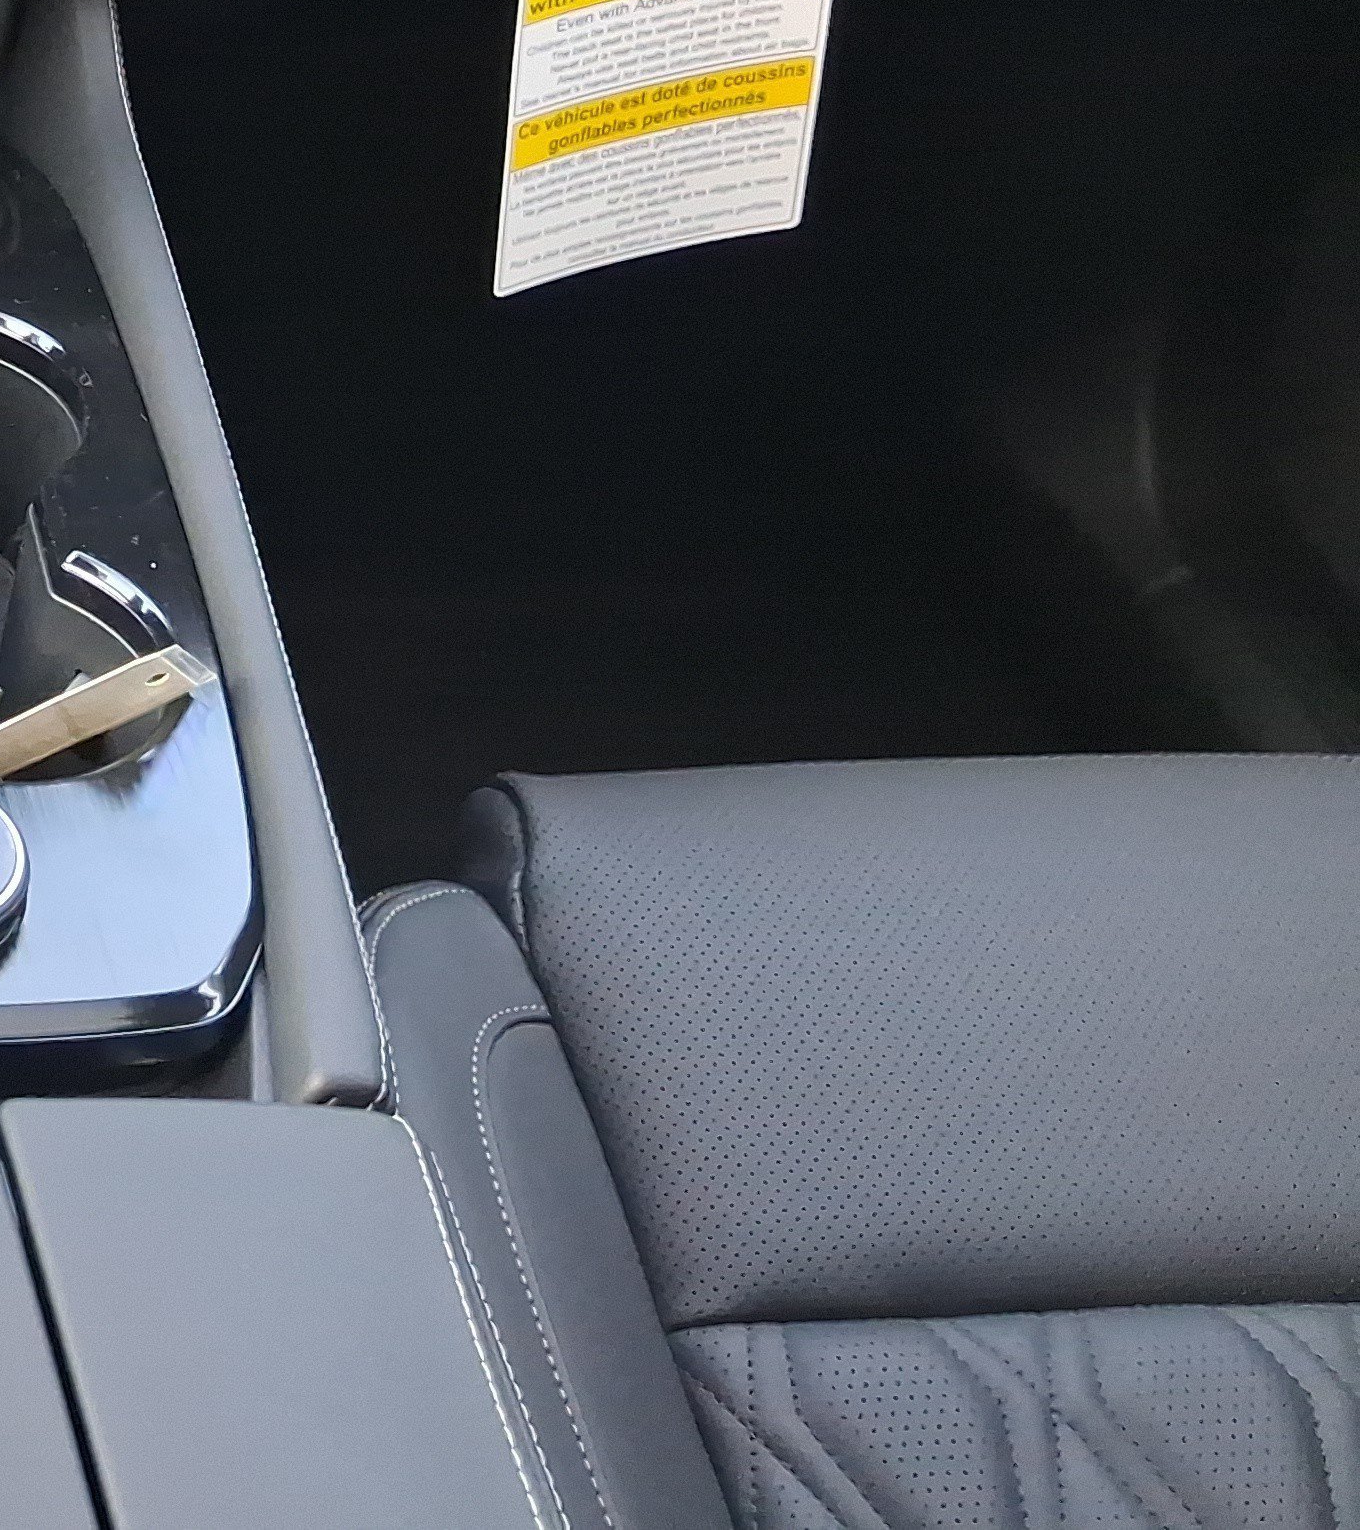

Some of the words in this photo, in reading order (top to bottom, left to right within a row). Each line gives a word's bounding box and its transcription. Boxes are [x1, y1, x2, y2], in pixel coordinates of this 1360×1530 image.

[557, 12, 593, 33] Even
[598, 0, 630, 20] with
[518, 122, 539, 140] Ce
[620, 92, 646, 111] est
[651, 81, 691, 103] doté
[695, 76, 718, 94] de
[723, 62, 808, 89] coussins
[547, 118, 637, 156] gonflables
